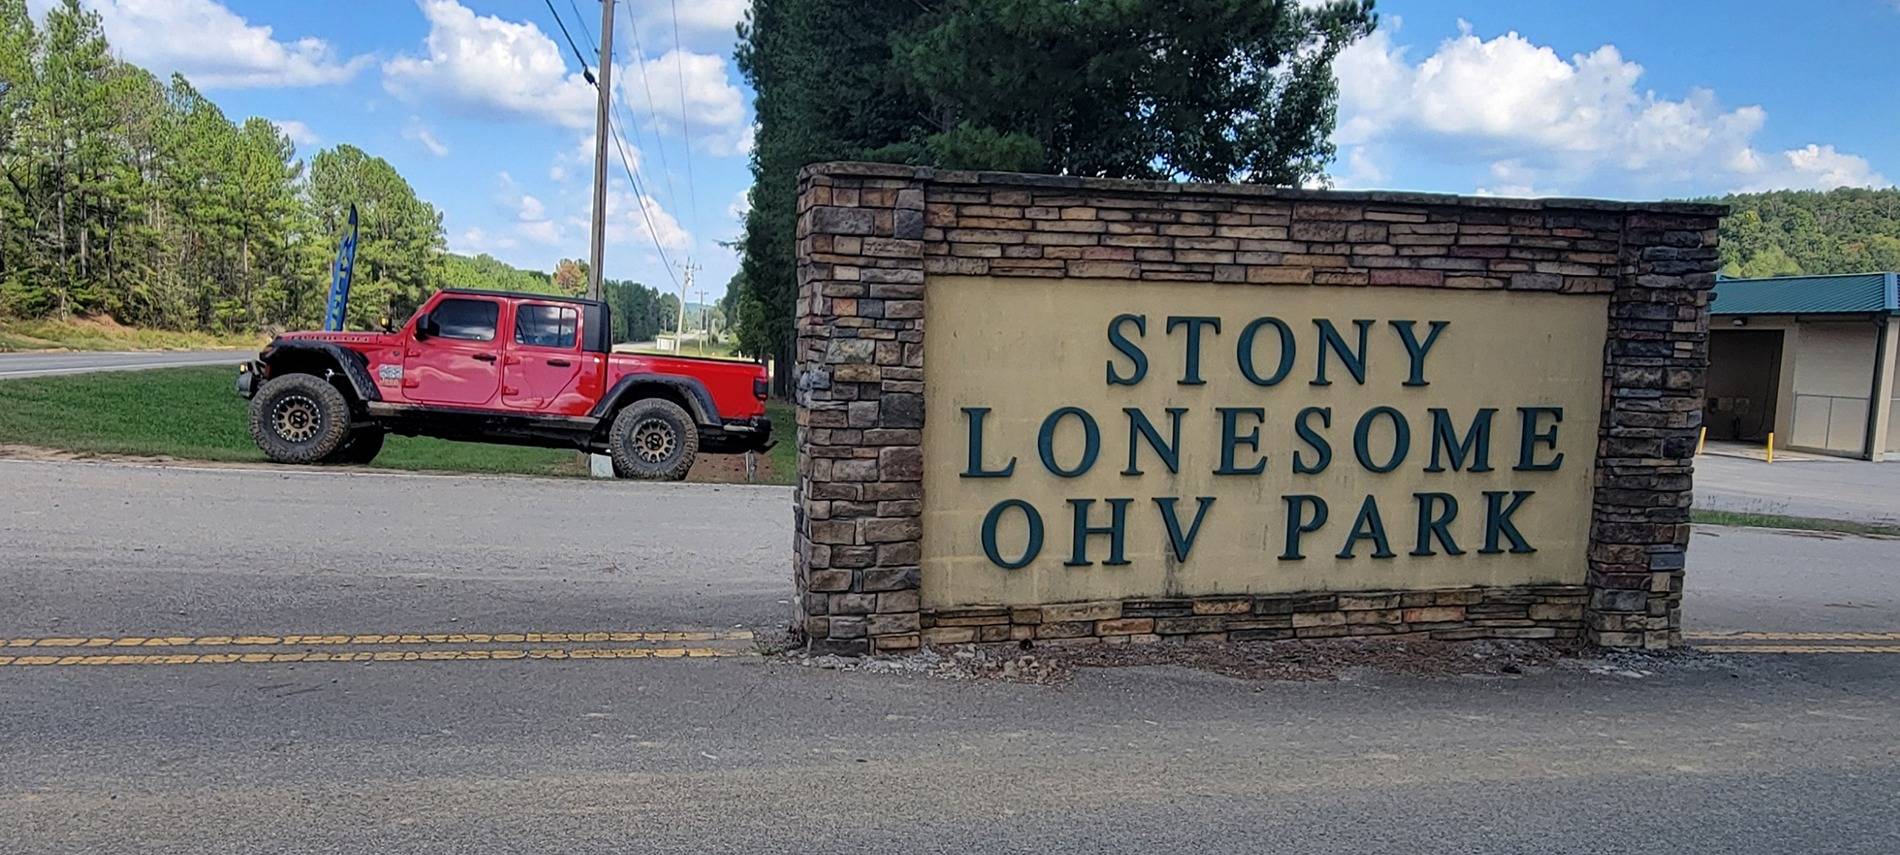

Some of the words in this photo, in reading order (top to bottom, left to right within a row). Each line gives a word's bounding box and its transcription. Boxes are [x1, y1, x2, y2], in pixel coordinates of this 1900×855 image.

[1106, 313, 1450, 387] STONY
[960, 405, 1566, 478] LONESOME
[981, 496, 1216, 570] OHV
[1278, 490, 1537, 561] PARK
